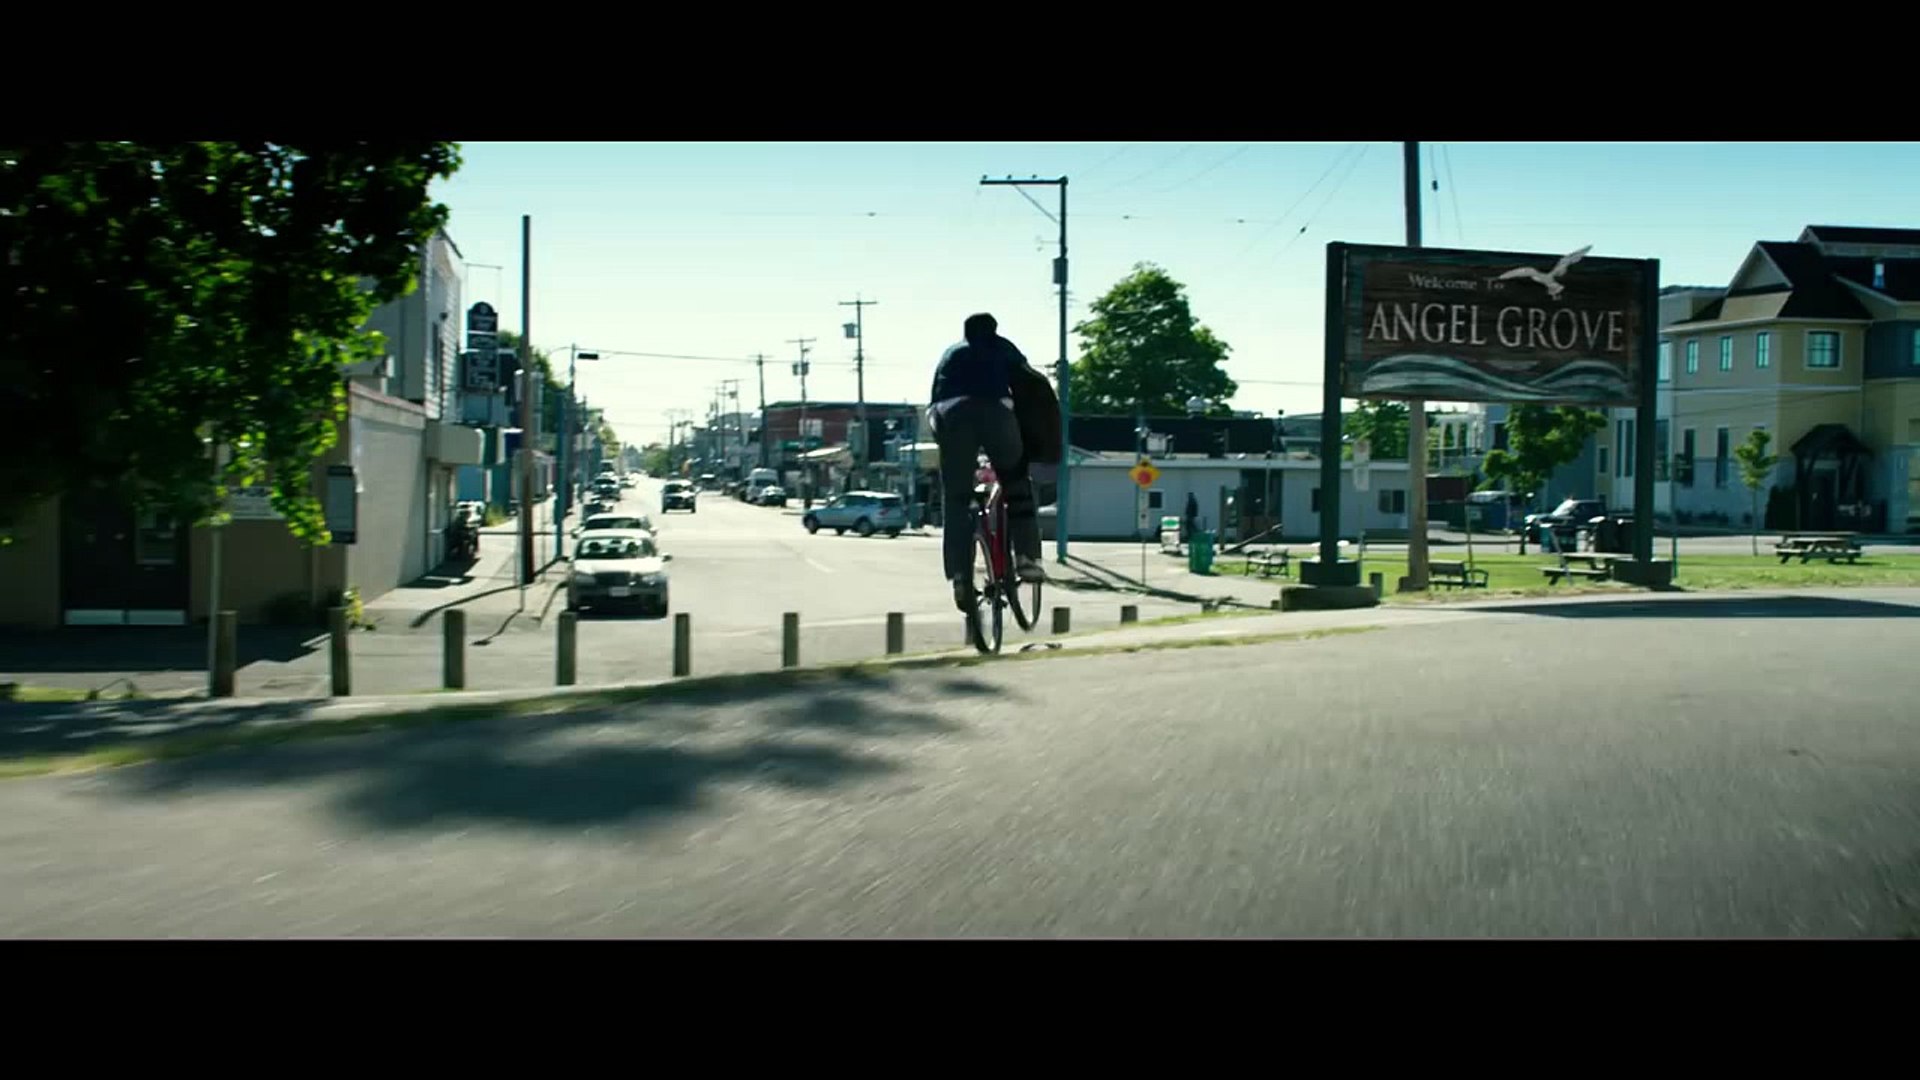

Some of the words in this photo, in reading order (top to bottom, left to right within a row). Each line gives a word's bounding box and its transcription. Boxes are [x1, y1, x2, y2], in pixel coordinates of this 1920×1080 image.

[1408, 272, 1477, 290] Welcome
[1483, 276, 1504, 291] To
[1367, 302, 1487, 345] ANGEL
[1496, 306, 1626, 351] GROVE
